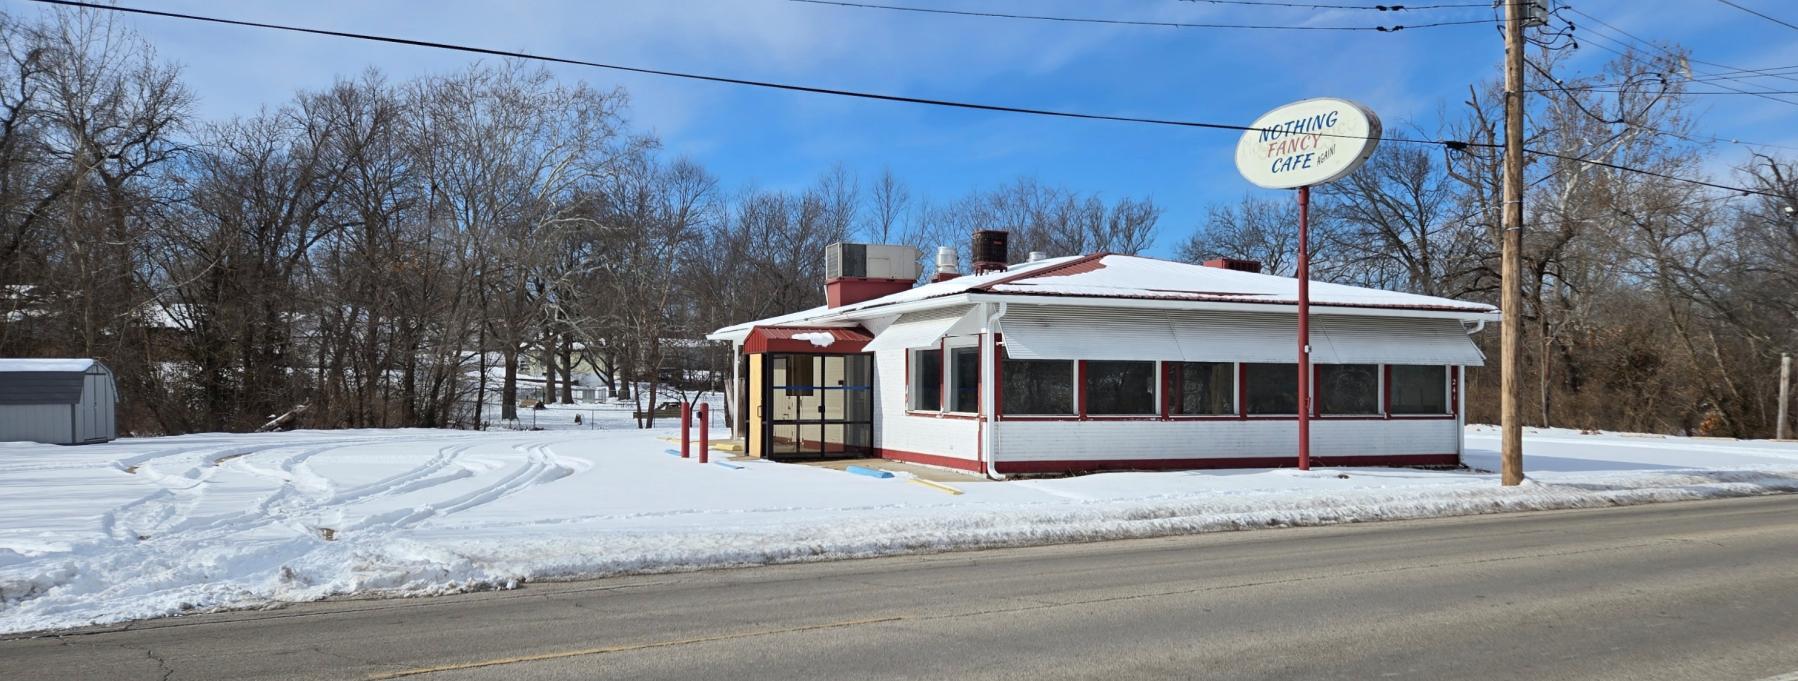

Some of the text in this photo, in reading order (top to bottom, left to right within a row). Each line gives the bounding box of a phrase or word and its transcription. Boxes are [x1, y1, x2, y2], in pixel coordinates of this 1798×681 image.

[1259, 110, 1338, 143] NOTHING
[1267, 134, 1320, 158] FANCY
[1271, 152, 1315, 173] CAFE
